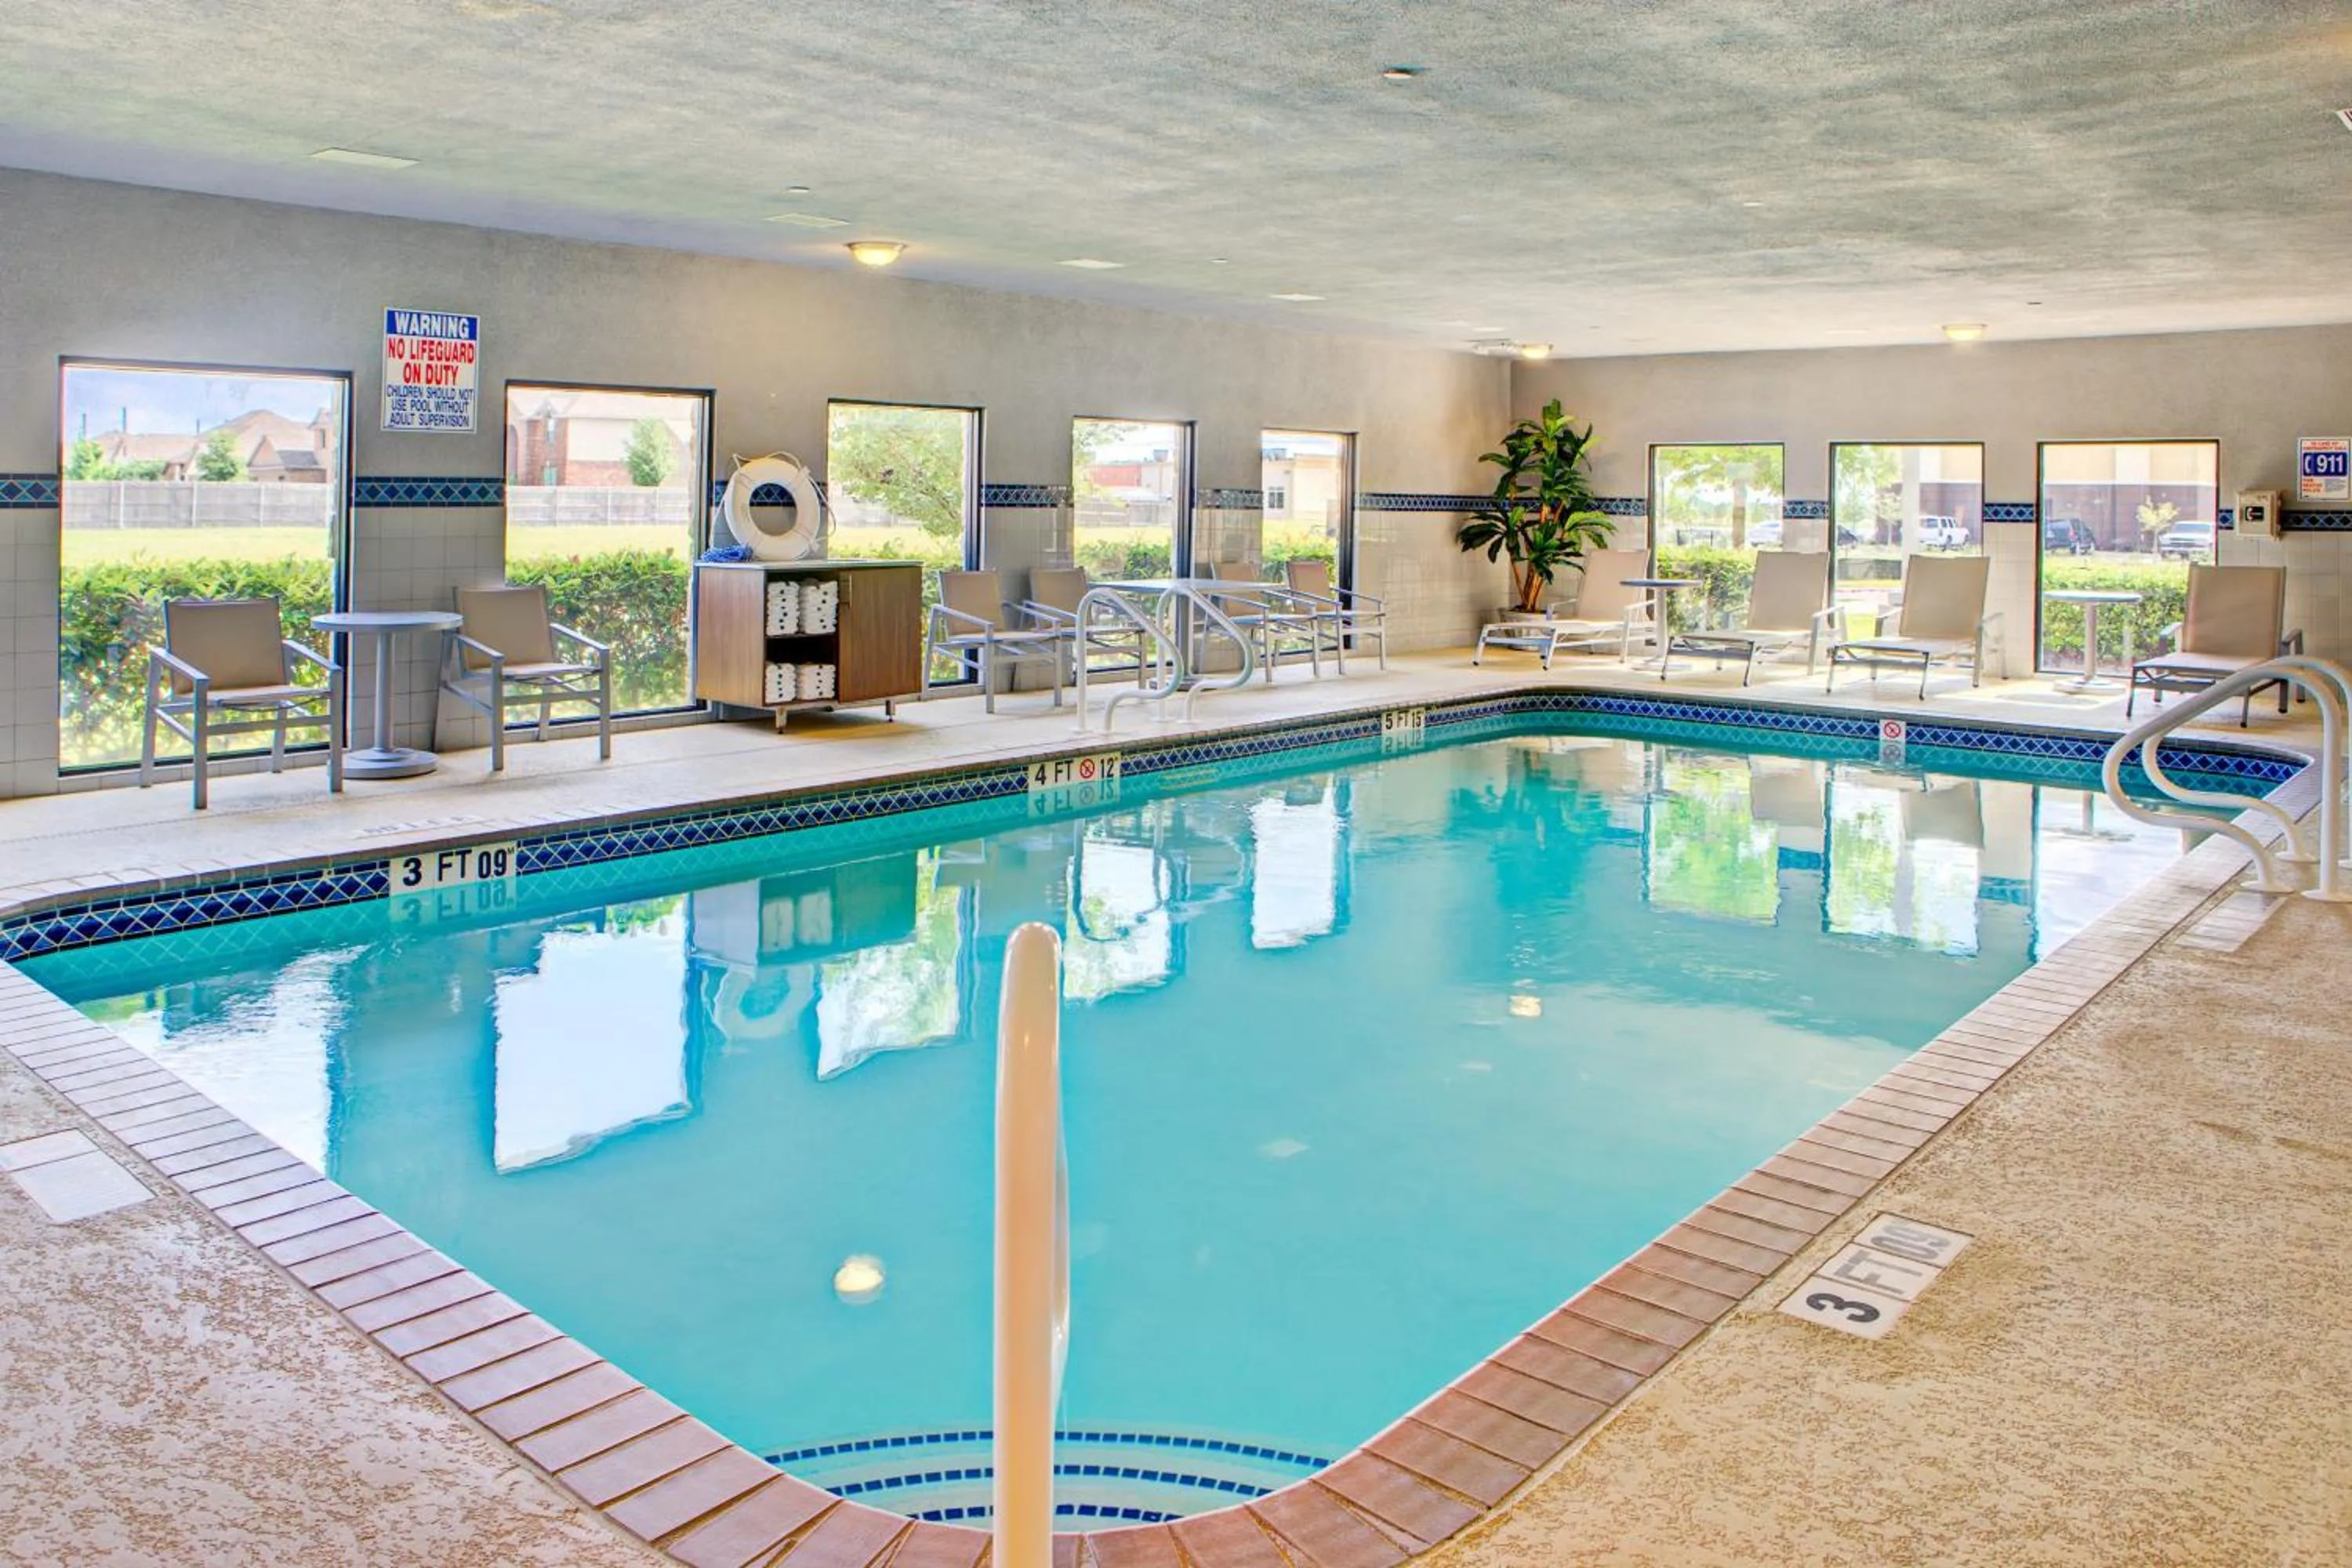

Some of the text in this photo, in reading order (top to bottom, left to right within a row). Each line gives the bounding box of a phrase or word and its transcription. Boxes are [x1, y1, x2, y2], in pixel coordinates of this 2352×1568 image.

[394, 311, 470, 339] WARNING
[388, 337, 475, 364] NO LIFEGUARD
[403, 362, 459, 385] ON DUTY
[387, 384, 474, 401] CHILDREN SHOULD NOT
[391, 398, 469, 414] USE POOL WITHOUT
[390, 412, 470, 427] ADULT SUPERVISION
[2317, 455, 2344, 473] 911
[1385, 713, 1393, 730] 5
[1397, 710, 1410, 728] FT
[1035, 764, 1047, 785] 4
[1054, 759, 1074, 782] FT
[402, 857, 423, 887] 3
[437, 848, 473, 882] FT
[1834, 1250, 1924, 1294] FT
[1806, 1293, 1880, 1323] 3
